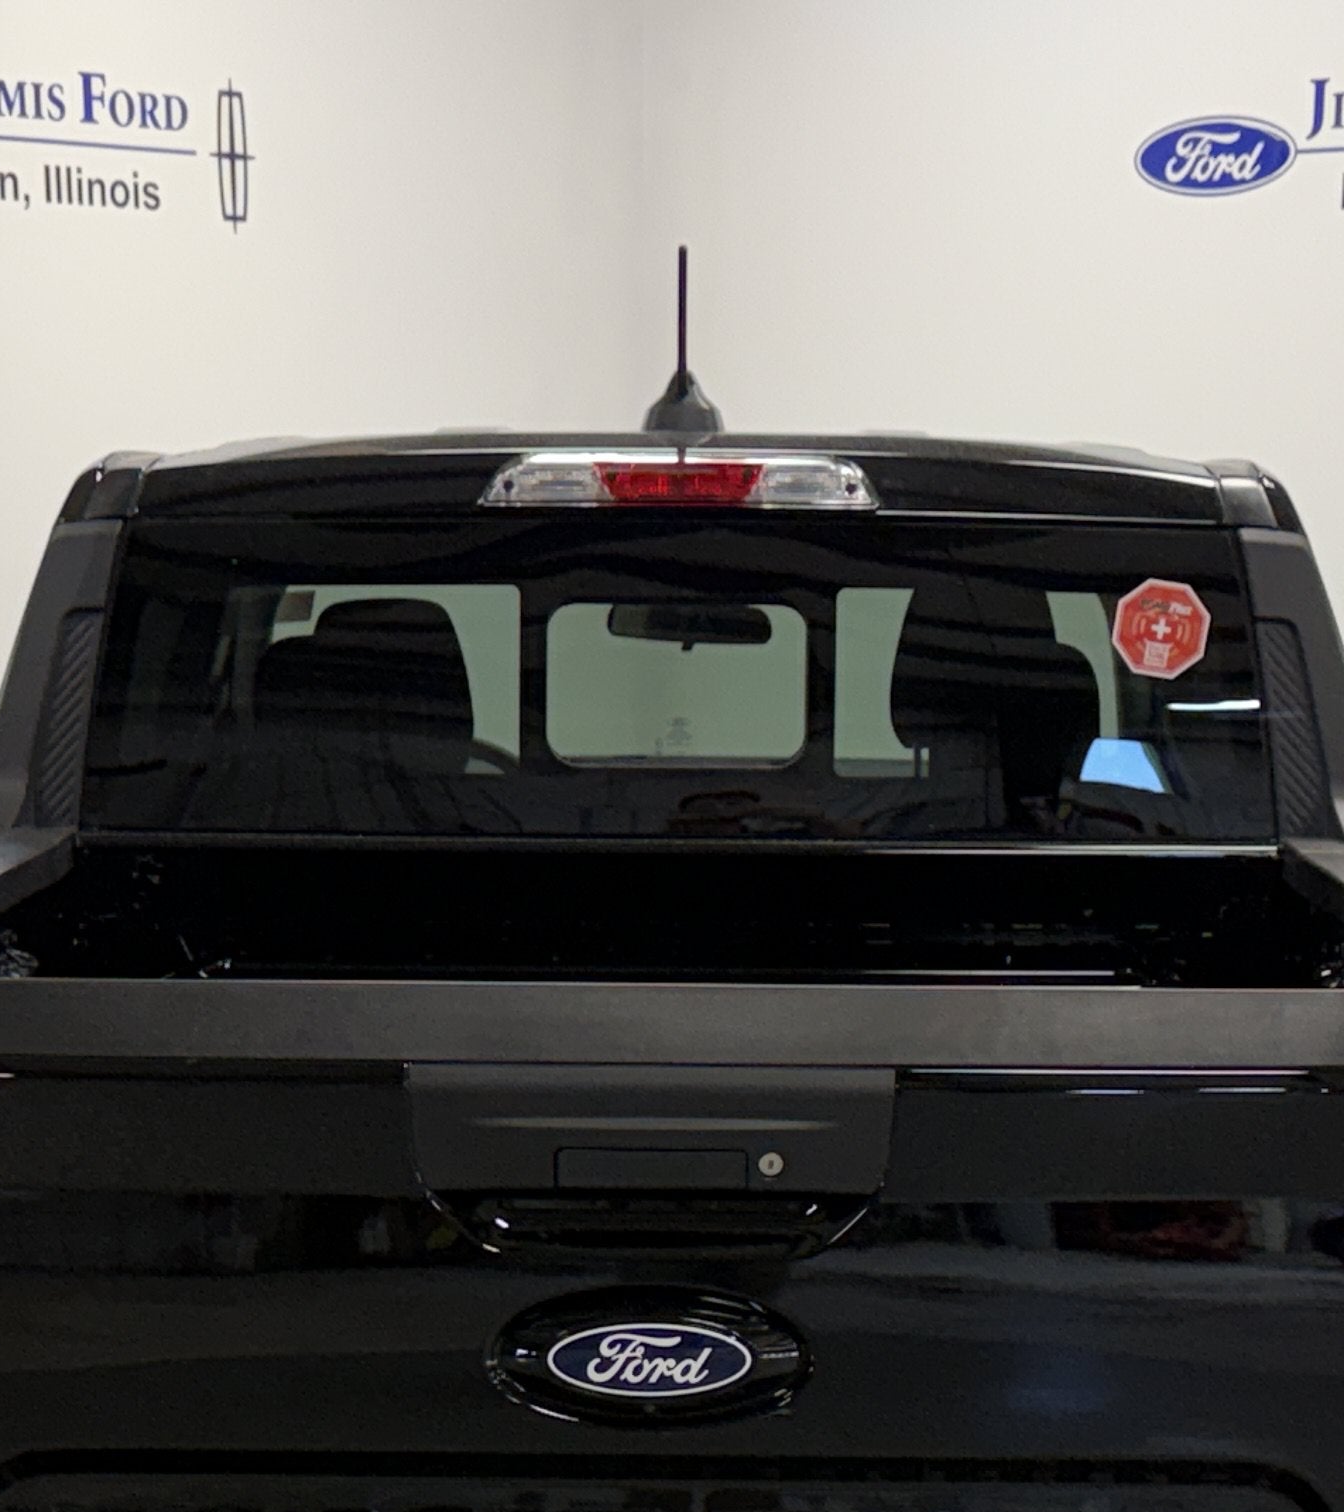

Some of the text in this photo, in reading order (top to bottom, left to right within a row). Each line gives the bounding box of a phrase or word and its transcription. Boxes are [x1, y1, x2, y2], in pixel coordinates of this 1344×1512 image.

[78, 72, 189, 132] FORD
[1164, 130, 1262, 183] Ford
[44, 164, 161, 211] Illinois
[586, 1332, 713, 1385] Ford
